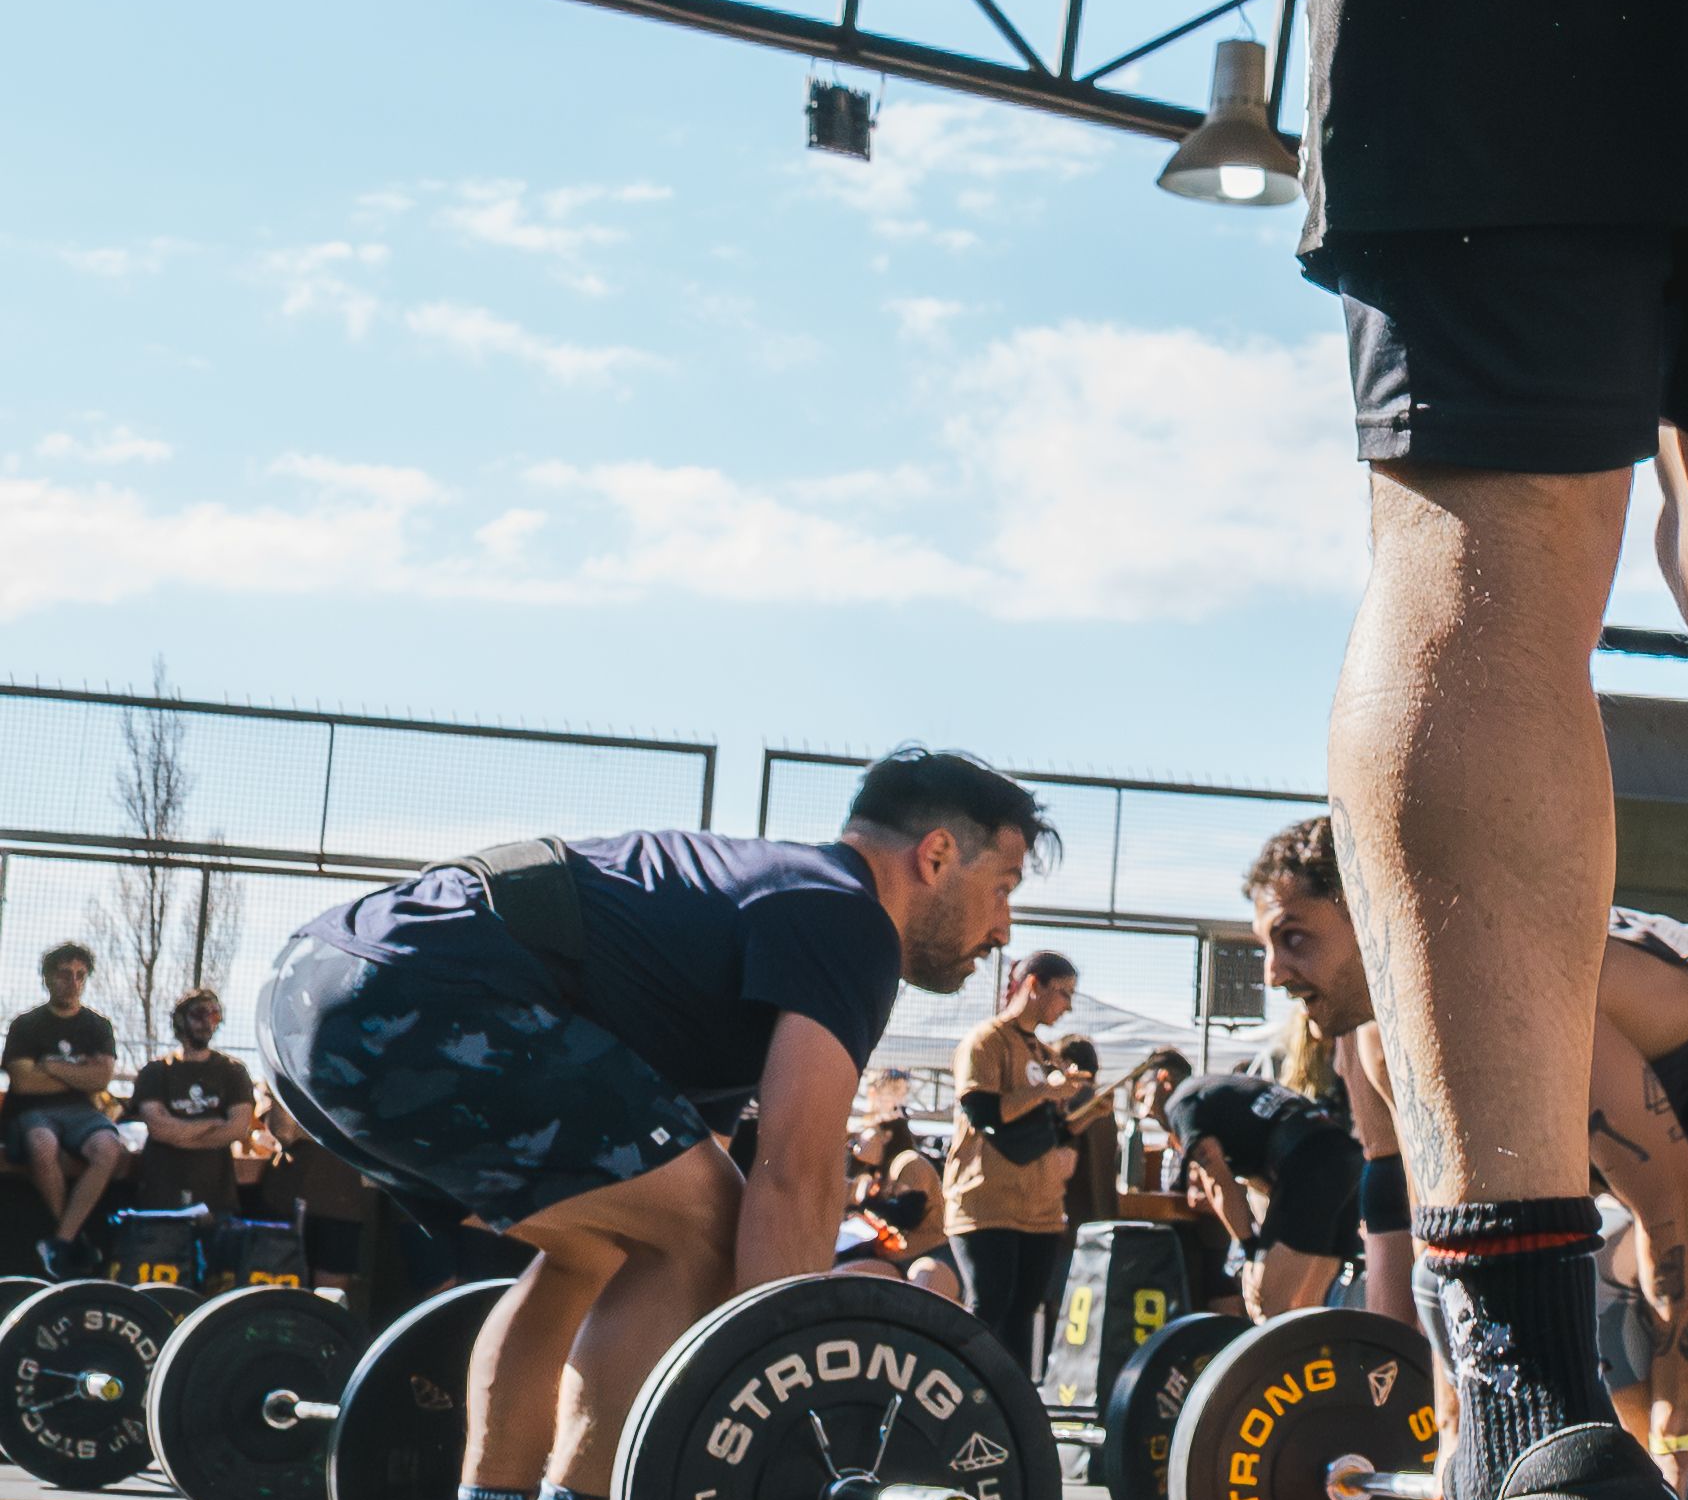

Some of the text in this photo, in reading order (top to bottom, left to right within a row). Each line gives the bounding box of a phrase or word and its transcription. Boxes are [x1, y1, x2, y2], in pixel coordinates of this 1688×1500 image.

[1065, 1286, 1092, 1346] 9
[1134, 1288, 1166, 1345] 9
[706, 1339, 963, 1465] STRONG
